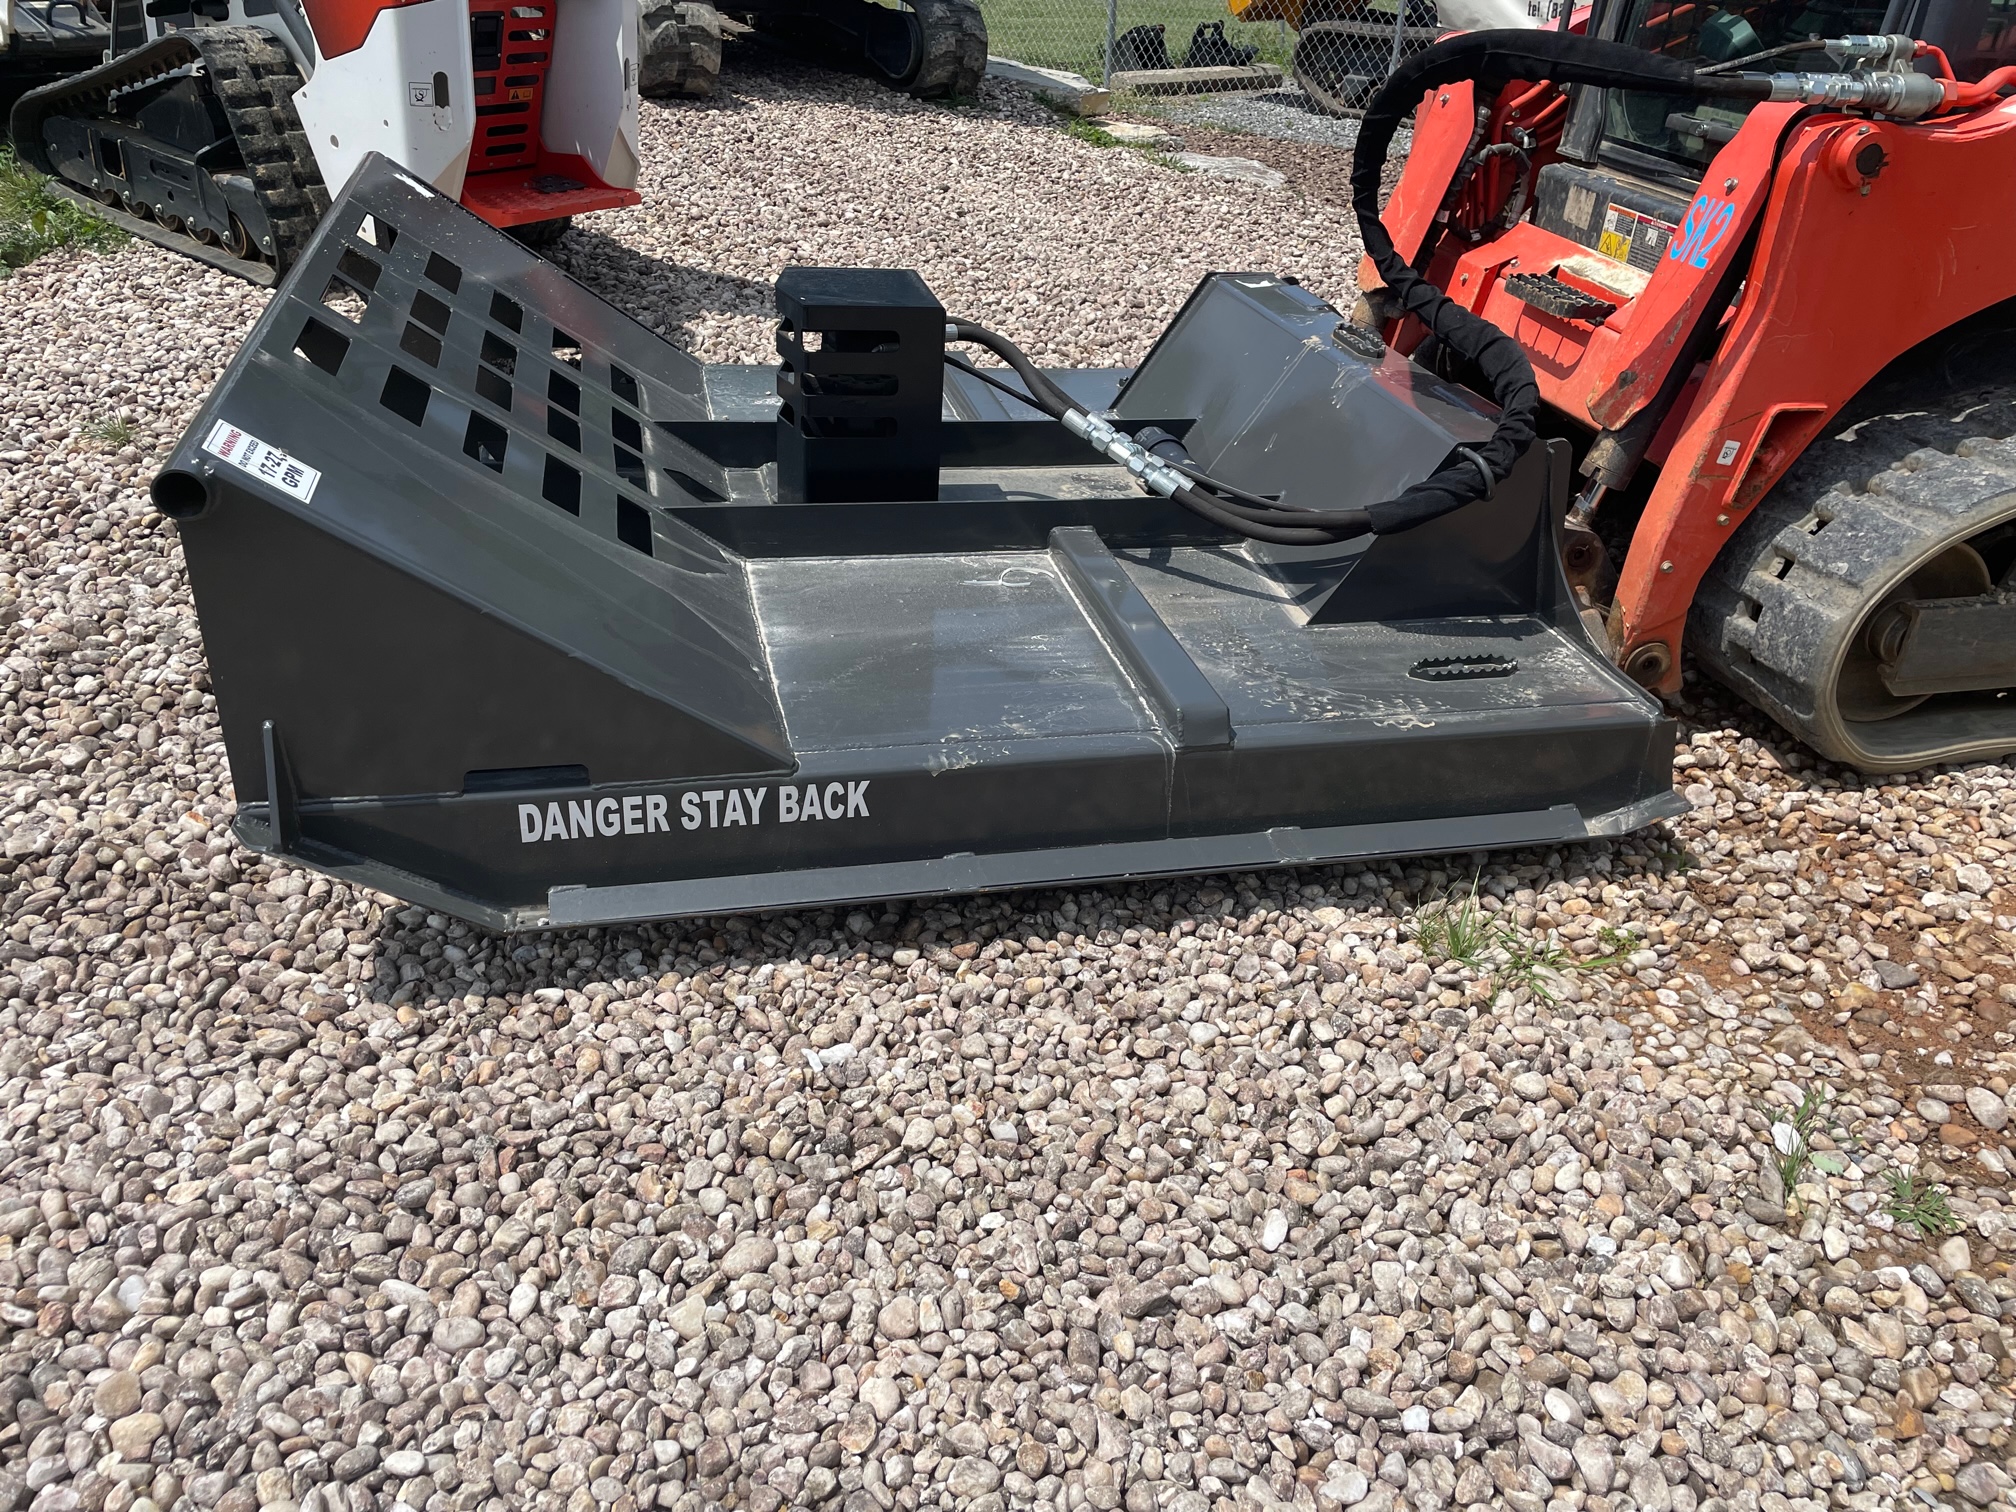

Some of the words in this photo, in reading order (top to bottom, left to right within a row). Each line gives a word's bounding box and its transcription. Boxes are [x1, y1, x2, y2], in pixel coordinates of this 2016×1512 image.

[1527, 0, 1543, 17] tel.
[1670, 195, 1735, 269] SK2
[218, 430, 242, 458] WARNING
[246, 439, 259, 454] EXCEED
[238, 459, 248, 467] DO
[242, 451, 252, 462] NOT
[258, 450, 284, 478] 17-27
[281, 464, 304, 488] GPM
[518, 793, 671, 843] DANGER
[680, 786, 767, 830] STAY
[779, 780, 871, 823] BACK
